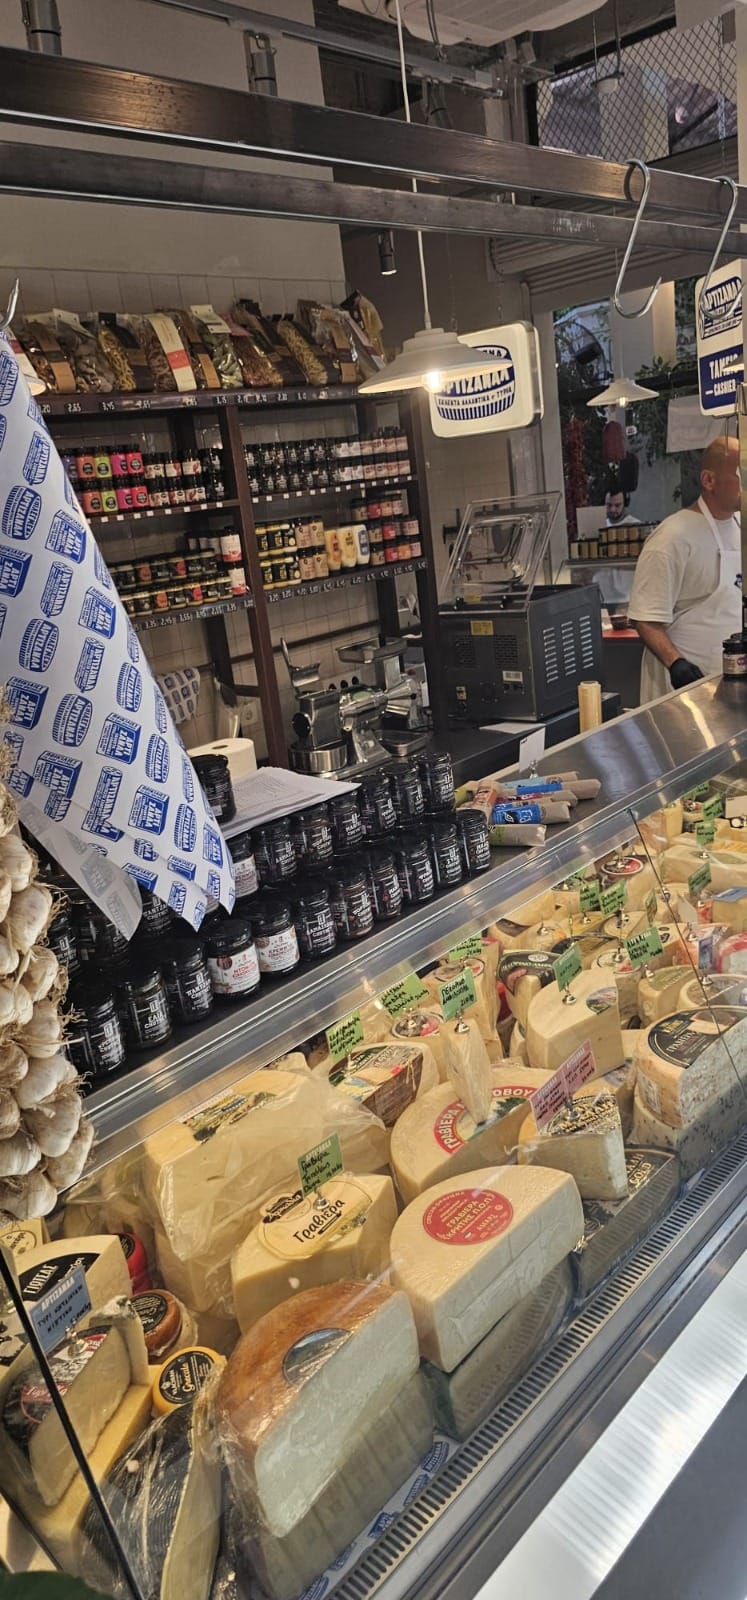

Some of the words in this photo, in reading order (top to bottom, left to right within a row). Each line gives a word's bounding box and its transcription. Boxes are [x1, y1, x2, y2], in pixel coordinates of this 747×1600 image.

[713, 379, 736, 396] CASHIER
[438, 1109, 461, 1150] ΓΡΑΒΙΕΡΑ
[293, 1199, 346, 1243] Γραβιέρα
[446, 1200, 479, 1228] ΓΡΑΒΙΕΡΑ
[446, 1214, 476, 1239] ΚΡΗΤΗΣ
